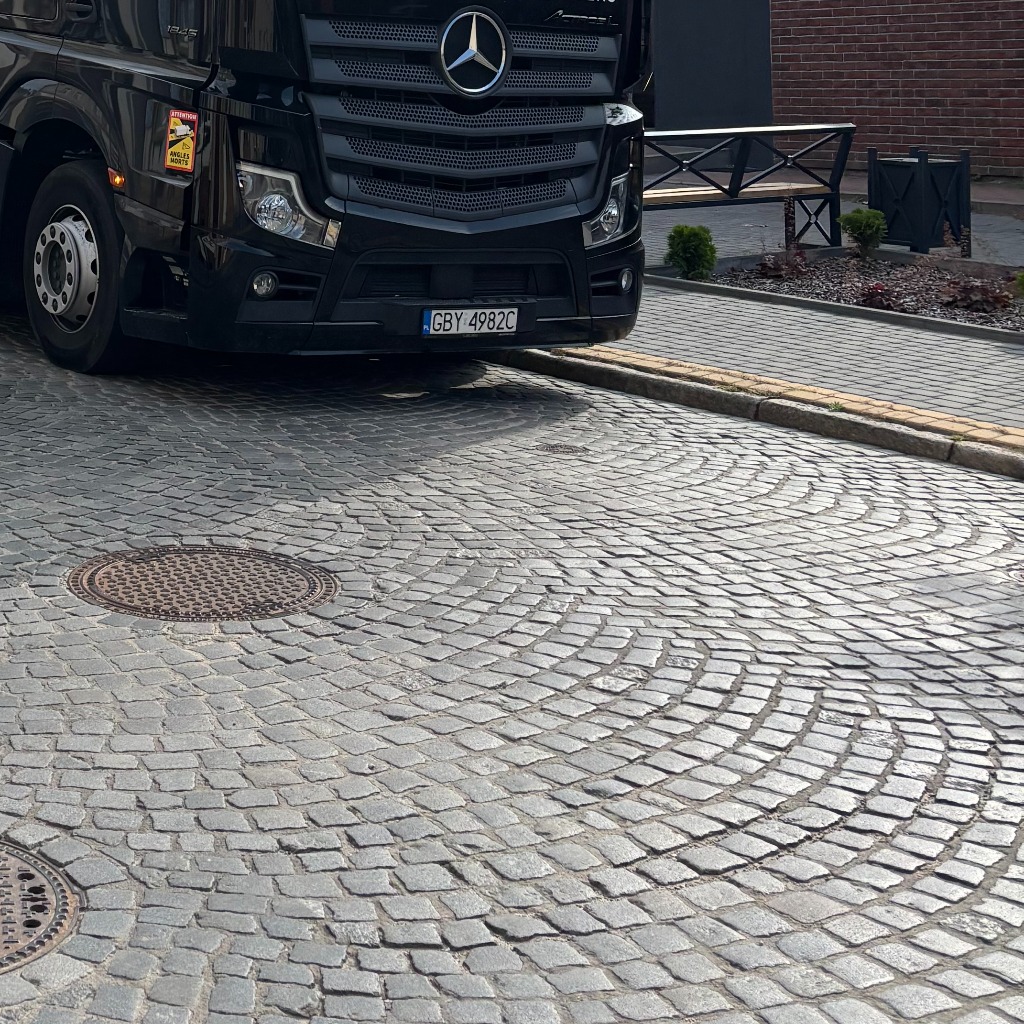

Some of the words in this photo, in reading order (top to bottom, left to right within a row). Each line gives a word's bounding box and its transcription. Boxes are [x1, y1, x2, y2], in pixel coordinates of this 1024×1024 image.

[170, 150, 190, 160] ANGLES
[170, 157, 189, 166] MORTS
[432, 311, 463, 332] GBY
[468, 310, 516, 331] 4982C
